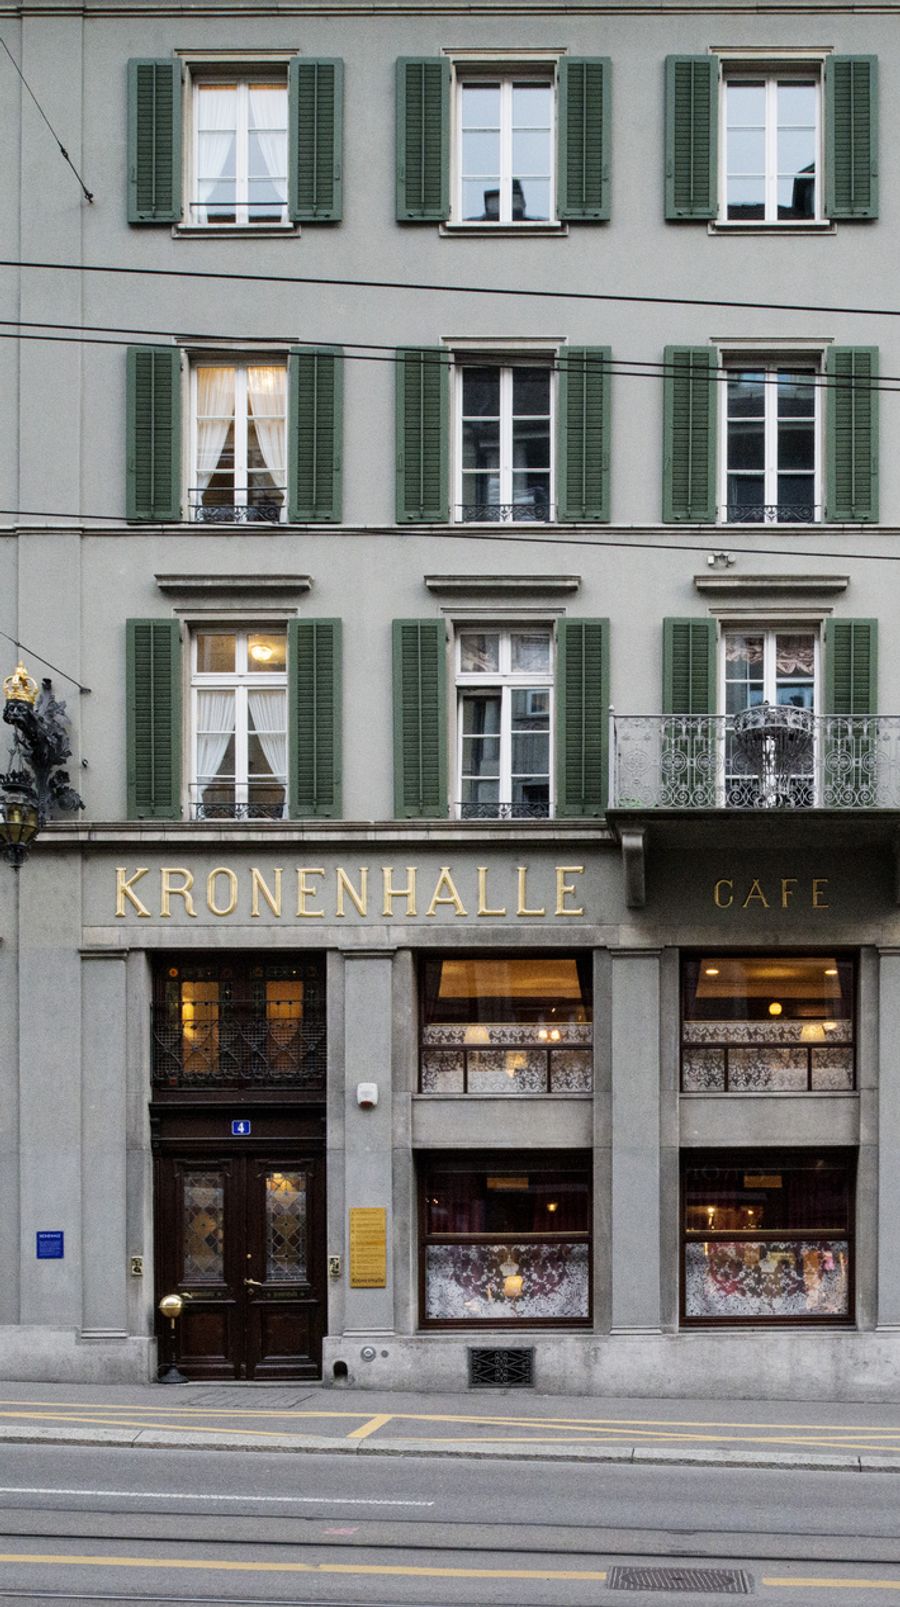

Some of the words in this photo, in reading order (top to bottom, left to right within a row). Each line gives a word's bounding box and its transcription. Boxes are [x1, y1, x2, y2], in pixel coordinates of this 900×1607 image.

[114, 865, 586, 918] KRONENHALLE
[713, 878, 830, 909] CAFE
[237, 1121, 245, 1134] 4
